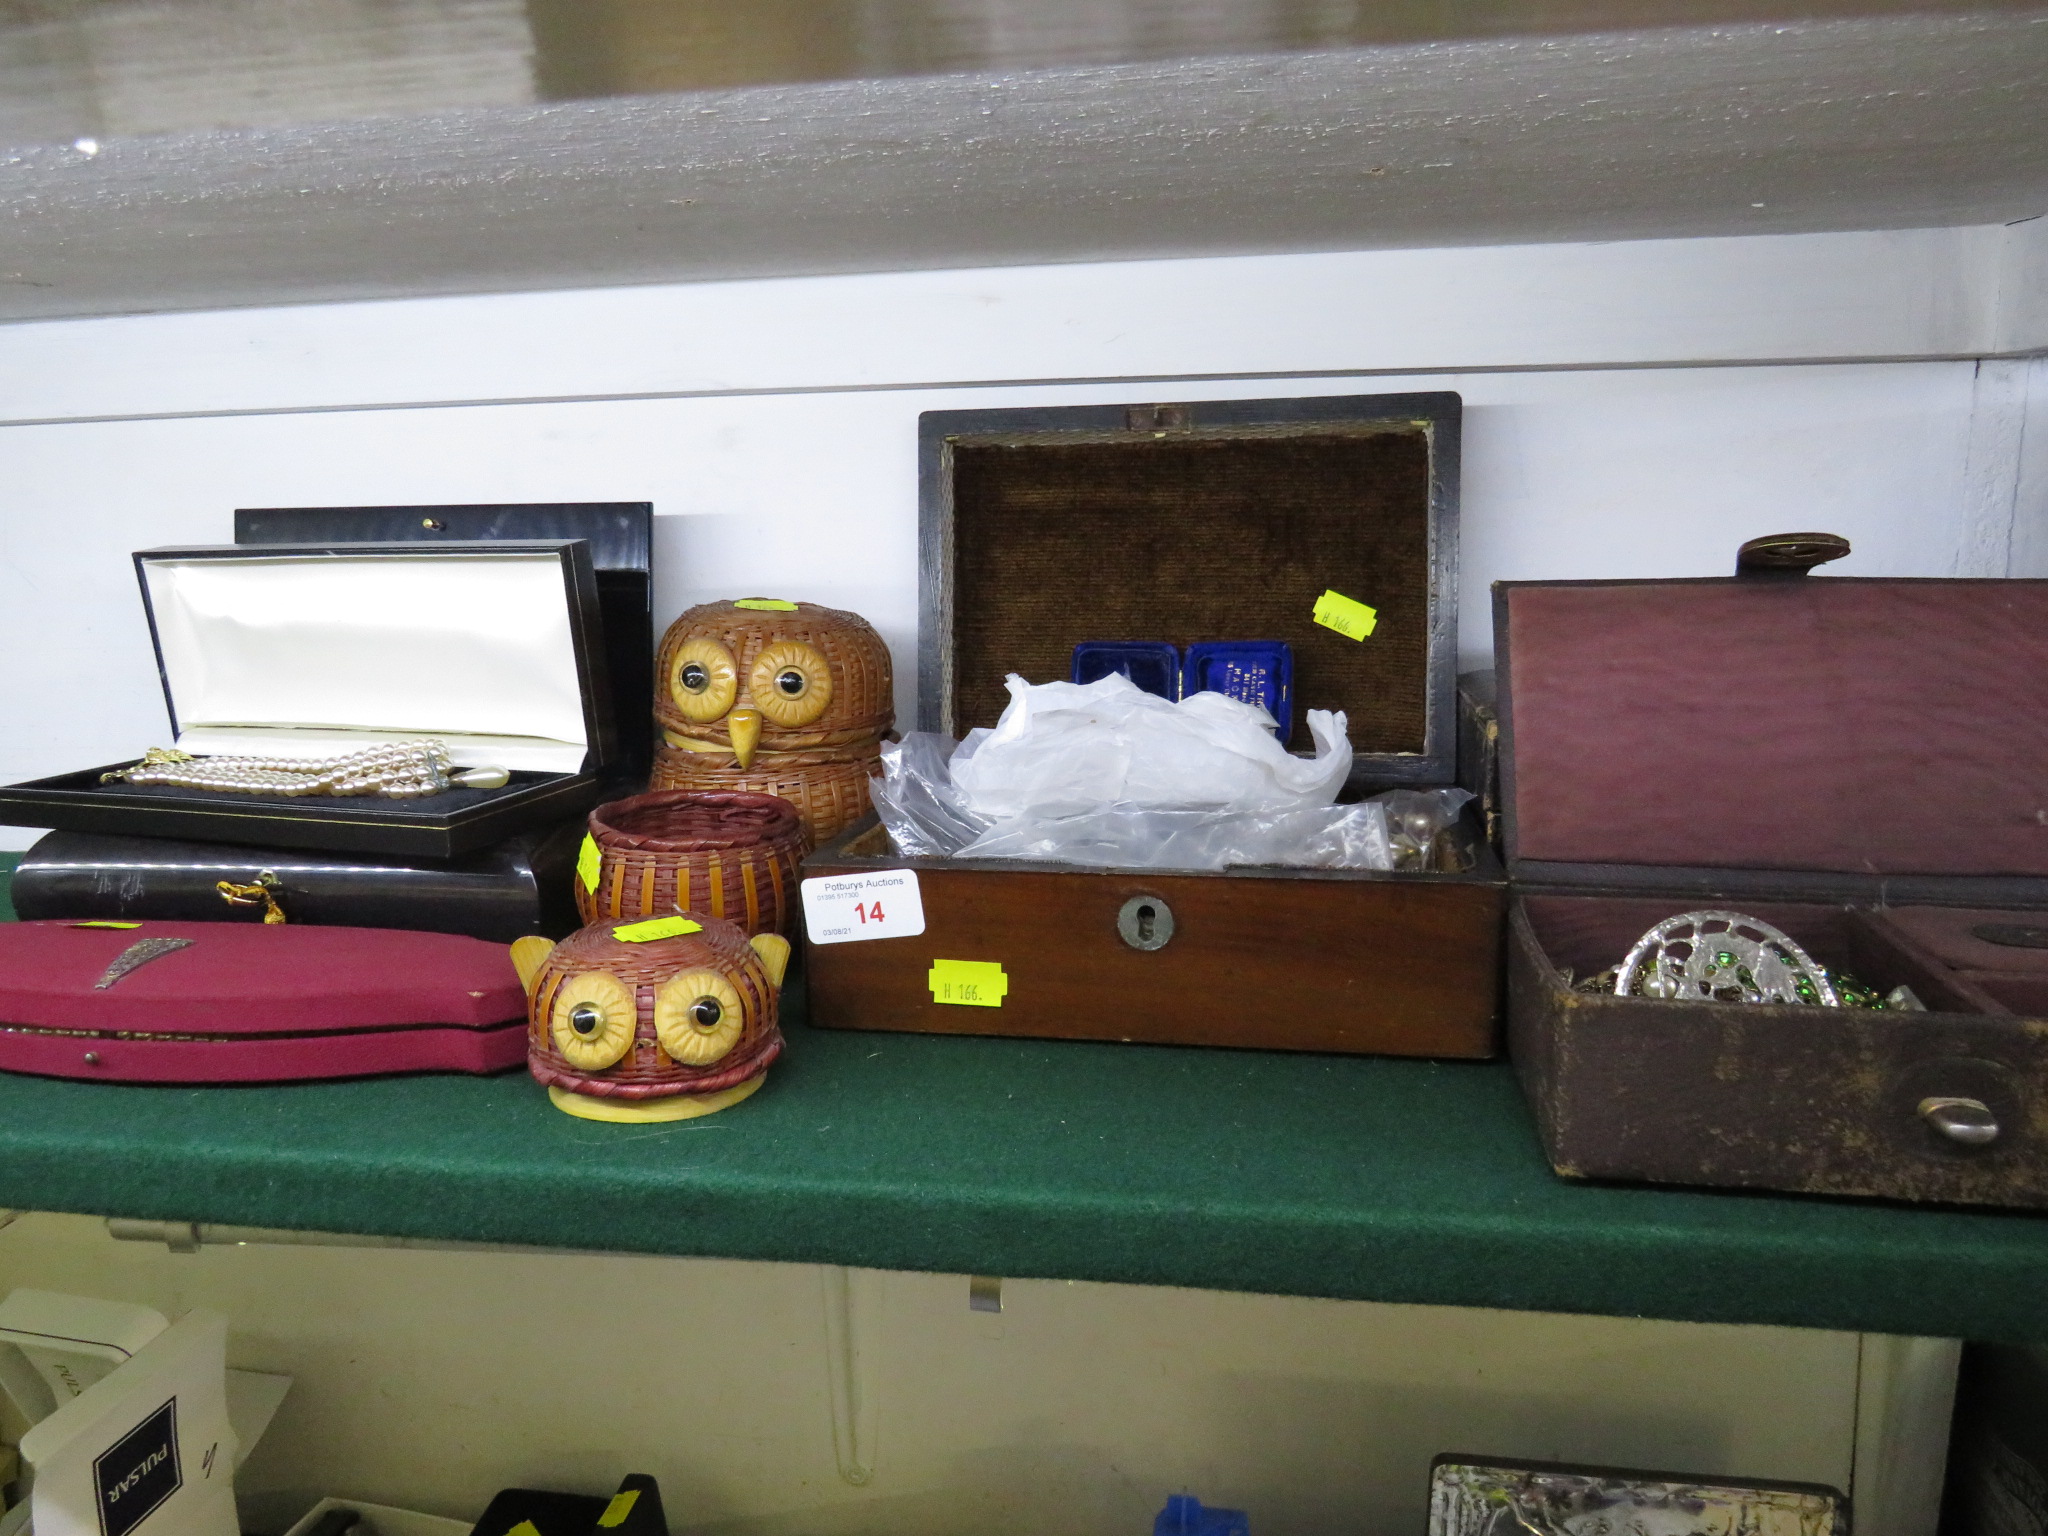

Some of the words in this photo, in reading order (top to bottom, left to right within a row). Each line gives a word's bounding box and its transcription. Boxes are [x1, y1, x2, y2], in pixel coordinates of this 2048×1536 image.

[1322, 612, 1330, 623] H
[824, 881, 863, 891] Potburys
[866, 878, 904, 888] Auctions
[854, 901, 885, 924] 14
[823, 928, 852, 936] 03/08/21
[944, 983, 950, 998] H
[108, 1443, 168, 1503] PULSAR
